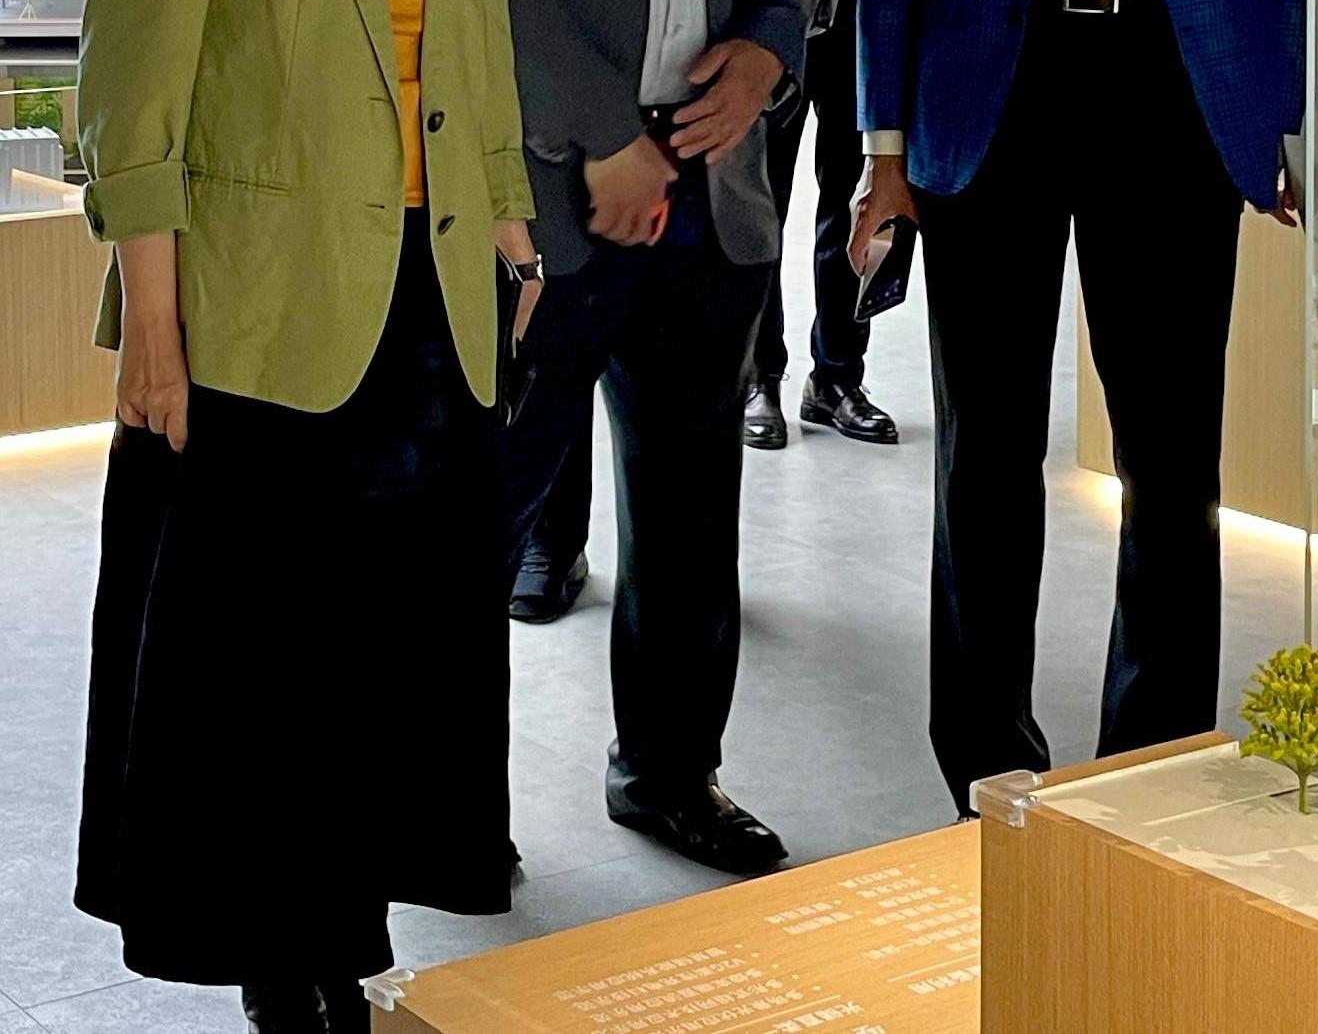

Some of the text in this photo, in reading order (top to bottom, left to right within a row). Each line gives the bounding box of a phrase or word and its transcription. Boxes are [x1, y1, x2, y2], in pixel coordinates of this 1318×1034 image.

[647, 989, 804, 1034] 多场景光伏应用示
